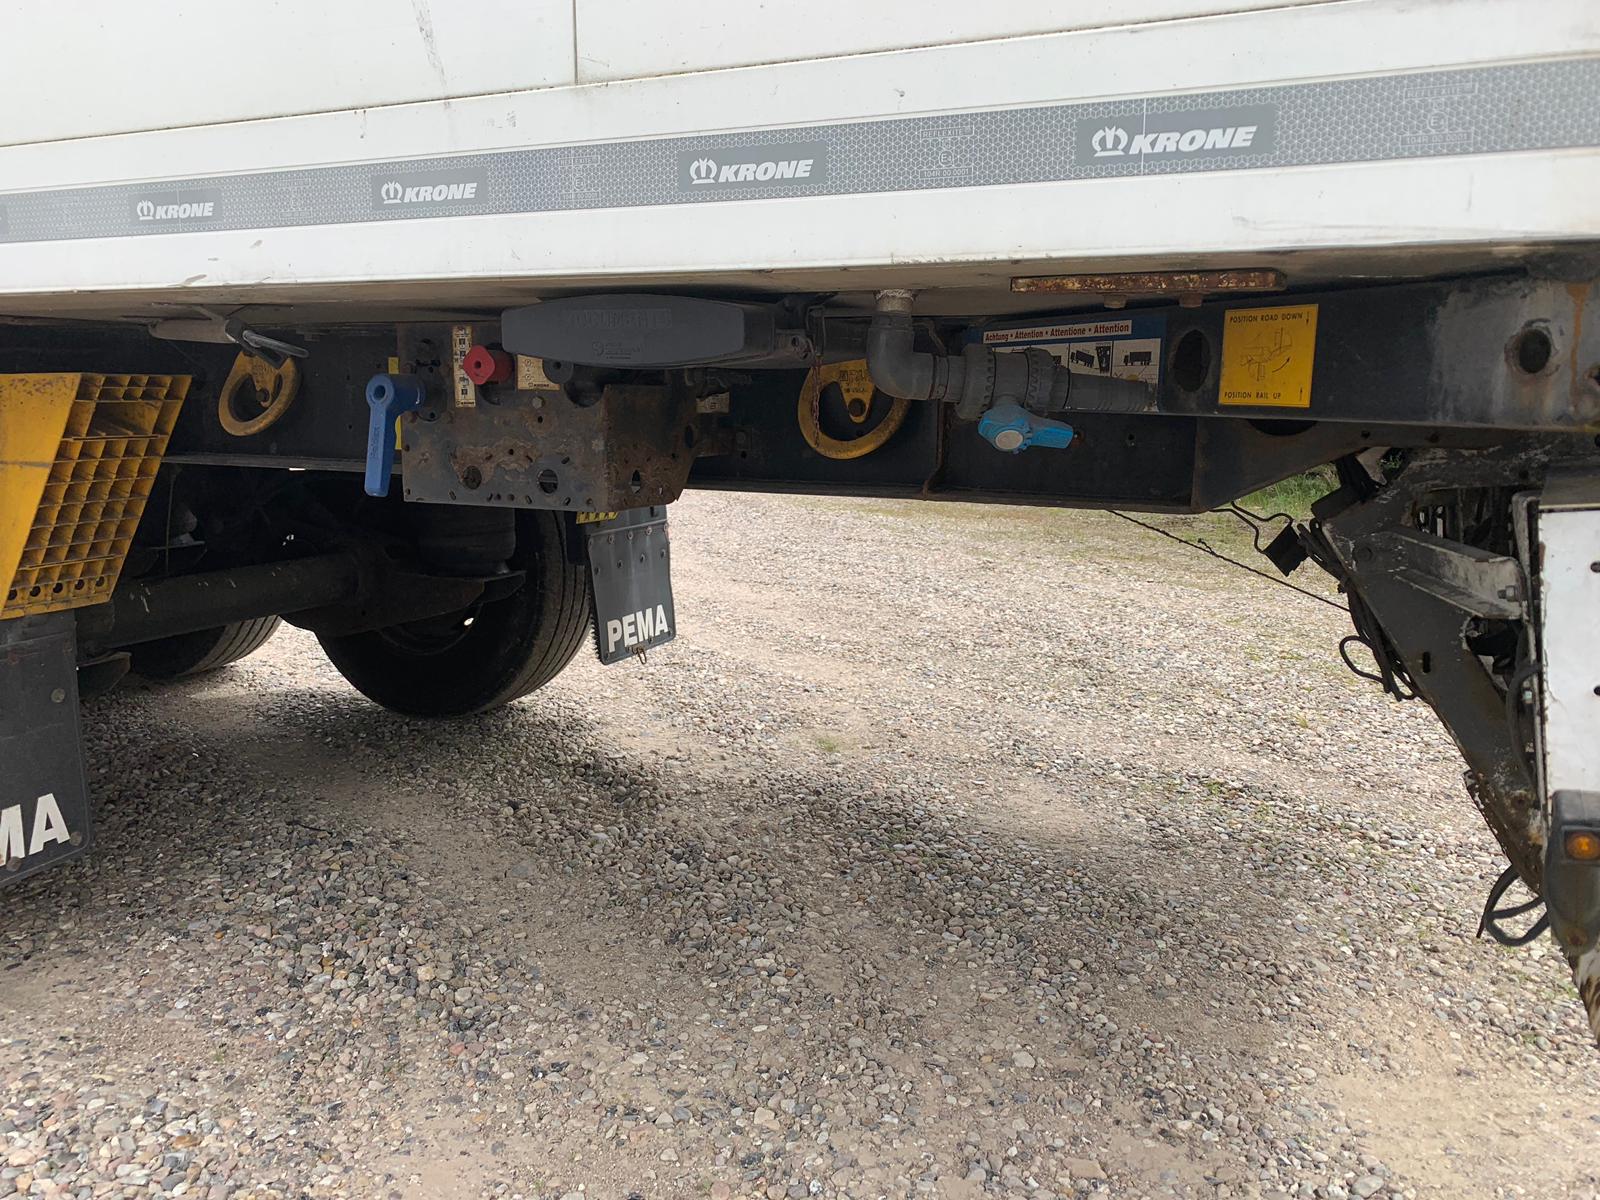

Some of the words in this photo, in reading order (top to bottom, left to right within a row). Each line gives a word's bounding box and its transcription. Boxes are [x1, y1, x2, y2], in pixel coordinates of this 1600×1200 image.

[1129, 125, 1258, 155] KRONE
[718, 159, 813, 182] KRONE
[404, 183, 478, 203] KRONE
[156, 202, 214, 219] KRONE
[1230, 315, 1257, 323] POSITION
[1282, 312, 1303, 320] DOWN
[985, 332, 1009, 342] Achtung
[1014, 330, 1044, 340] Attention
[1050, 326, 1086, 337] Attentione
[1093, 323, 1130, 334] Attention
[606, 604, 669, 653] PEMA
